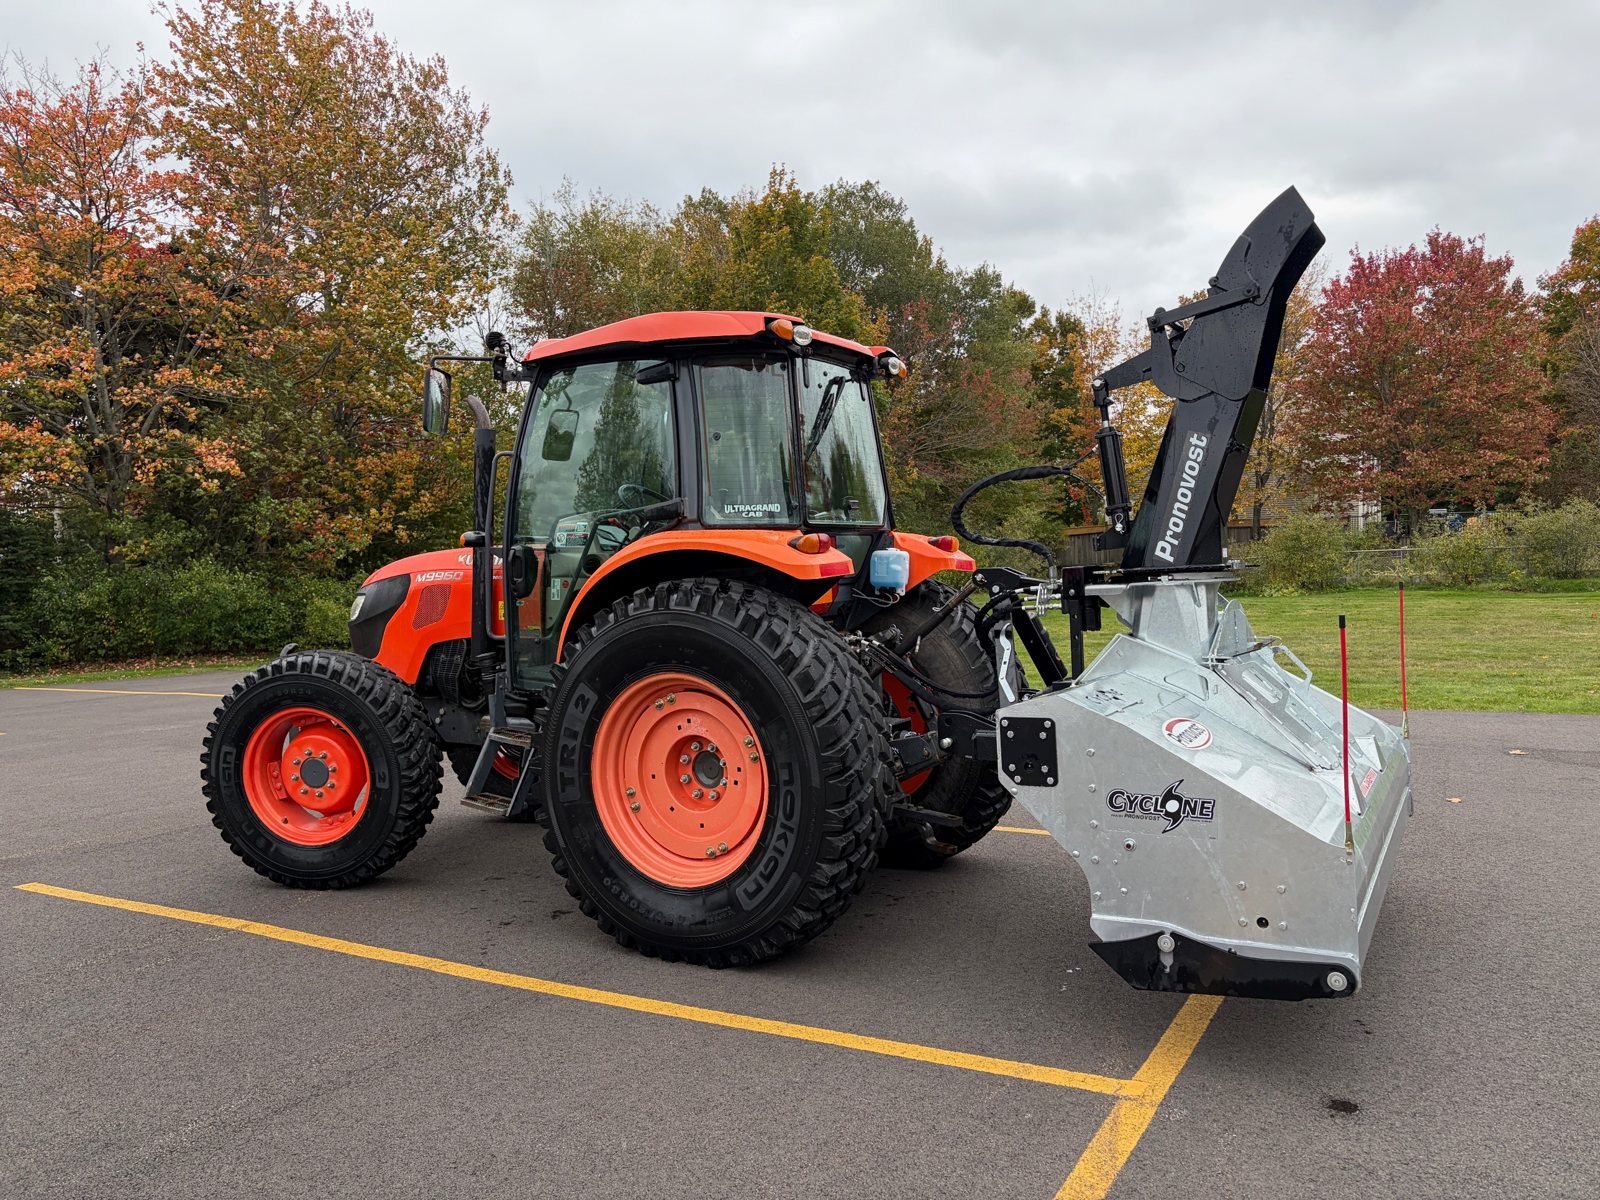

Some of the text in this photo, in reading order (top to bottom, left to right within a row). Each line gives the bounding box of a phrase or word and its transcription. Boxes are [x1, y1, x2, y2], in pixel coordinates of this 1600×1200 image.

[724, 503, 781, 514] ULTRAGRAND
[1154, 433, 1209, 563] Pronovost
[415, 571, 464, 582] M9960
[559, 693, 591, 793] TRI 2
[1106, 780, 1215, 831] CYCLONE
[1124, 813, 1160, 821] PRONOVOST
